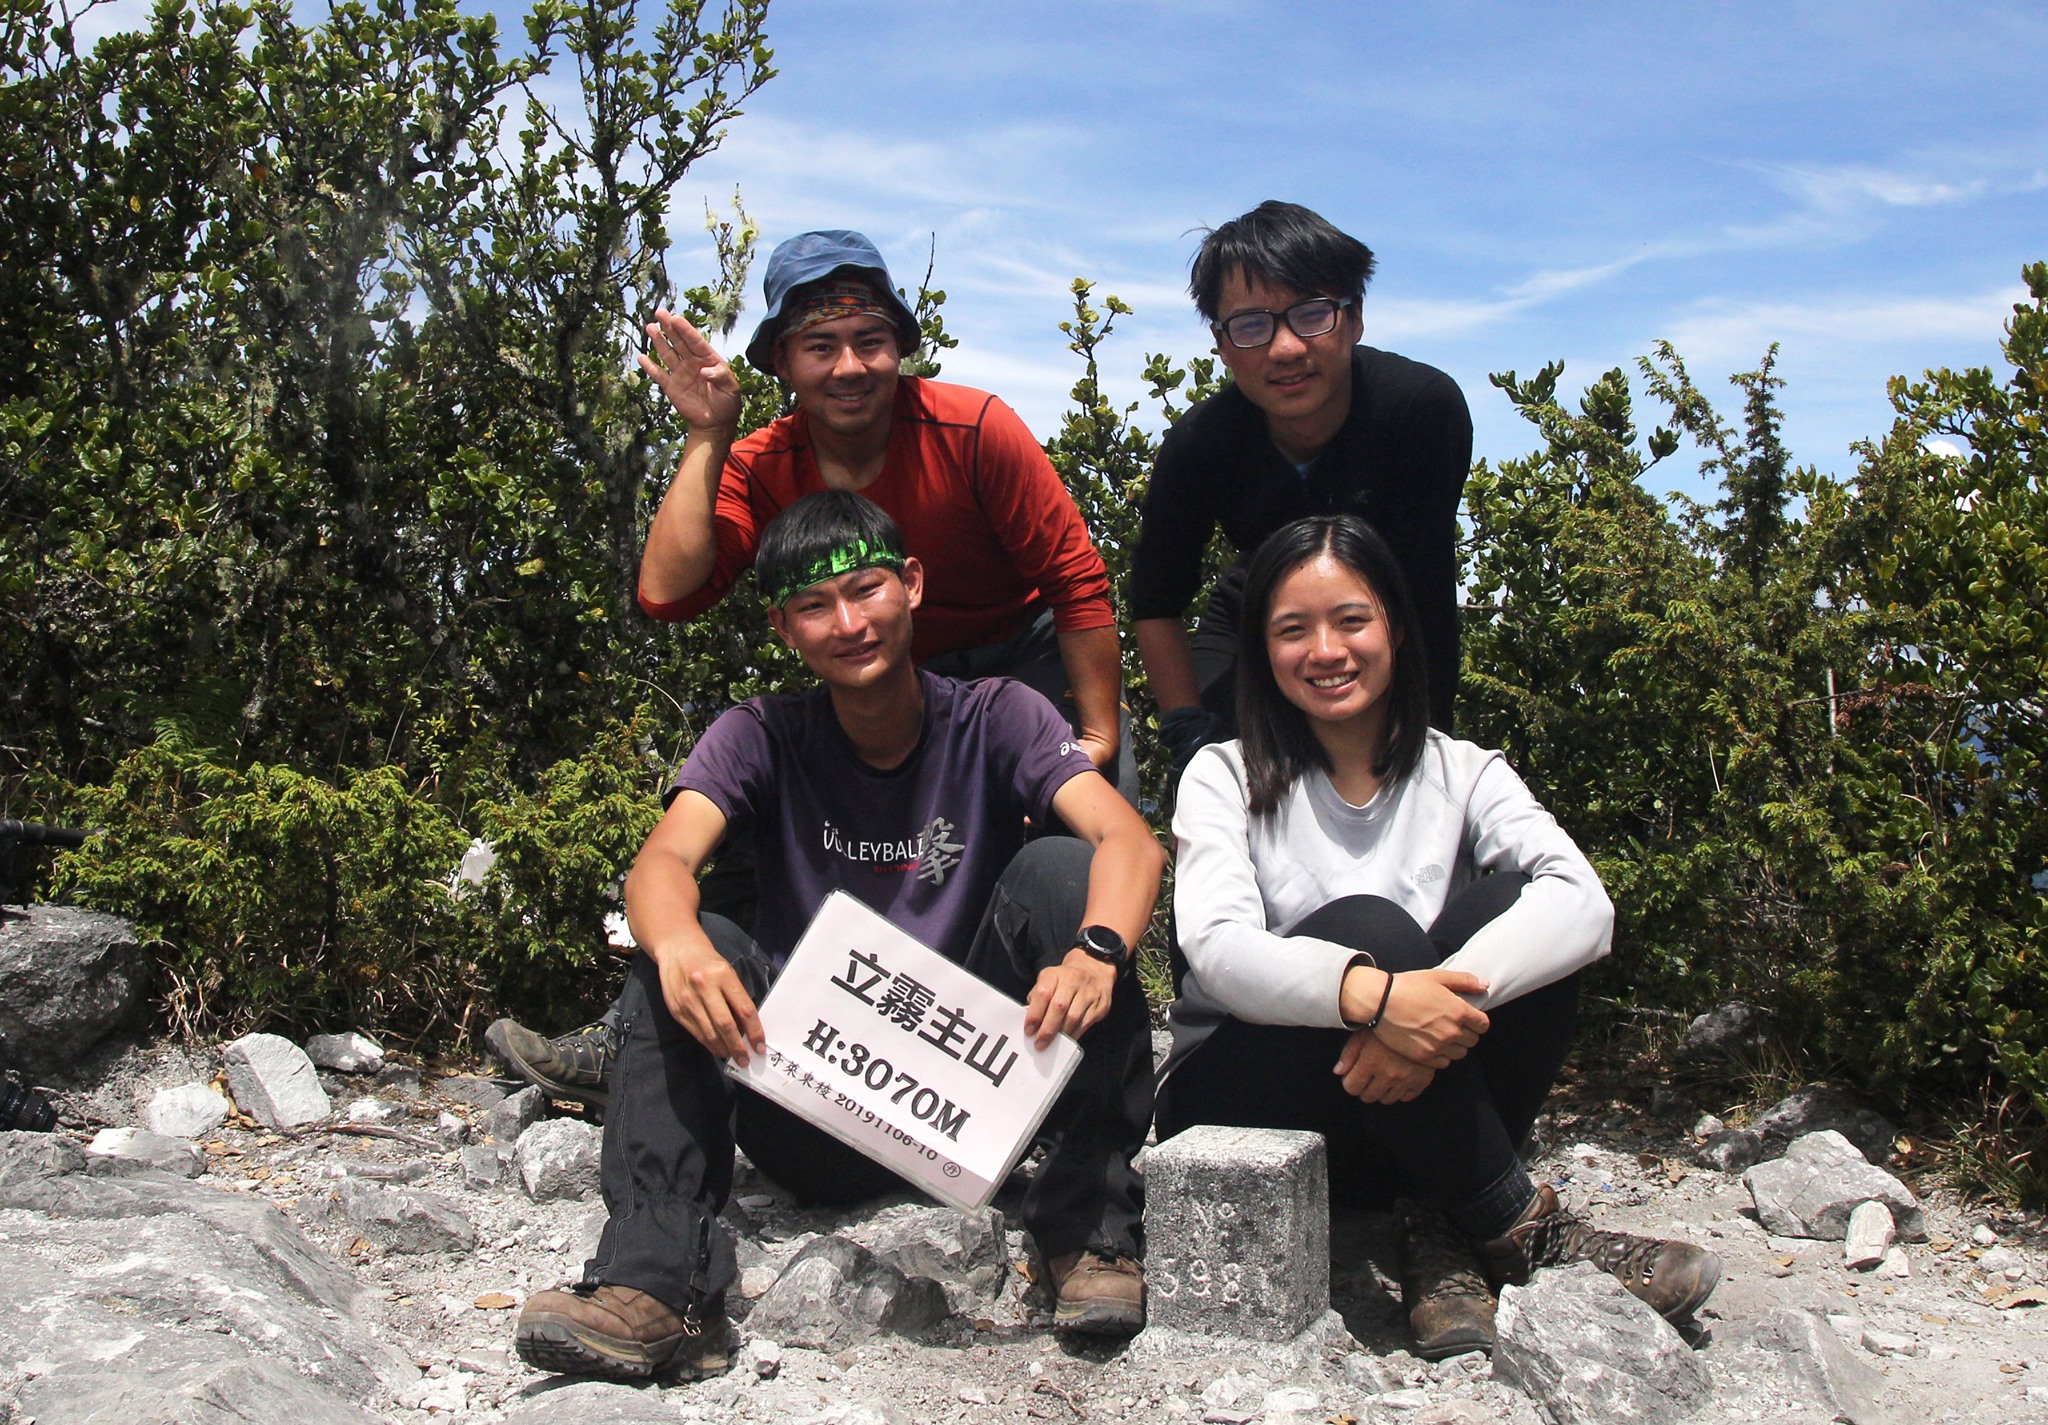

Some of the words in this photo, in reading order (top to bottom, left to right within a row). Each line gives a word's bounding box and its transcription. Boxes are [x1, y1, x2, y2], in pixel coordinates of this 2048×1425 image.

[802, 1018, 972, 1143] H:3070M
[830, 948, 1019, 1088] 立霧主山
[834, 1093, 938, 1162] 20191106-10
